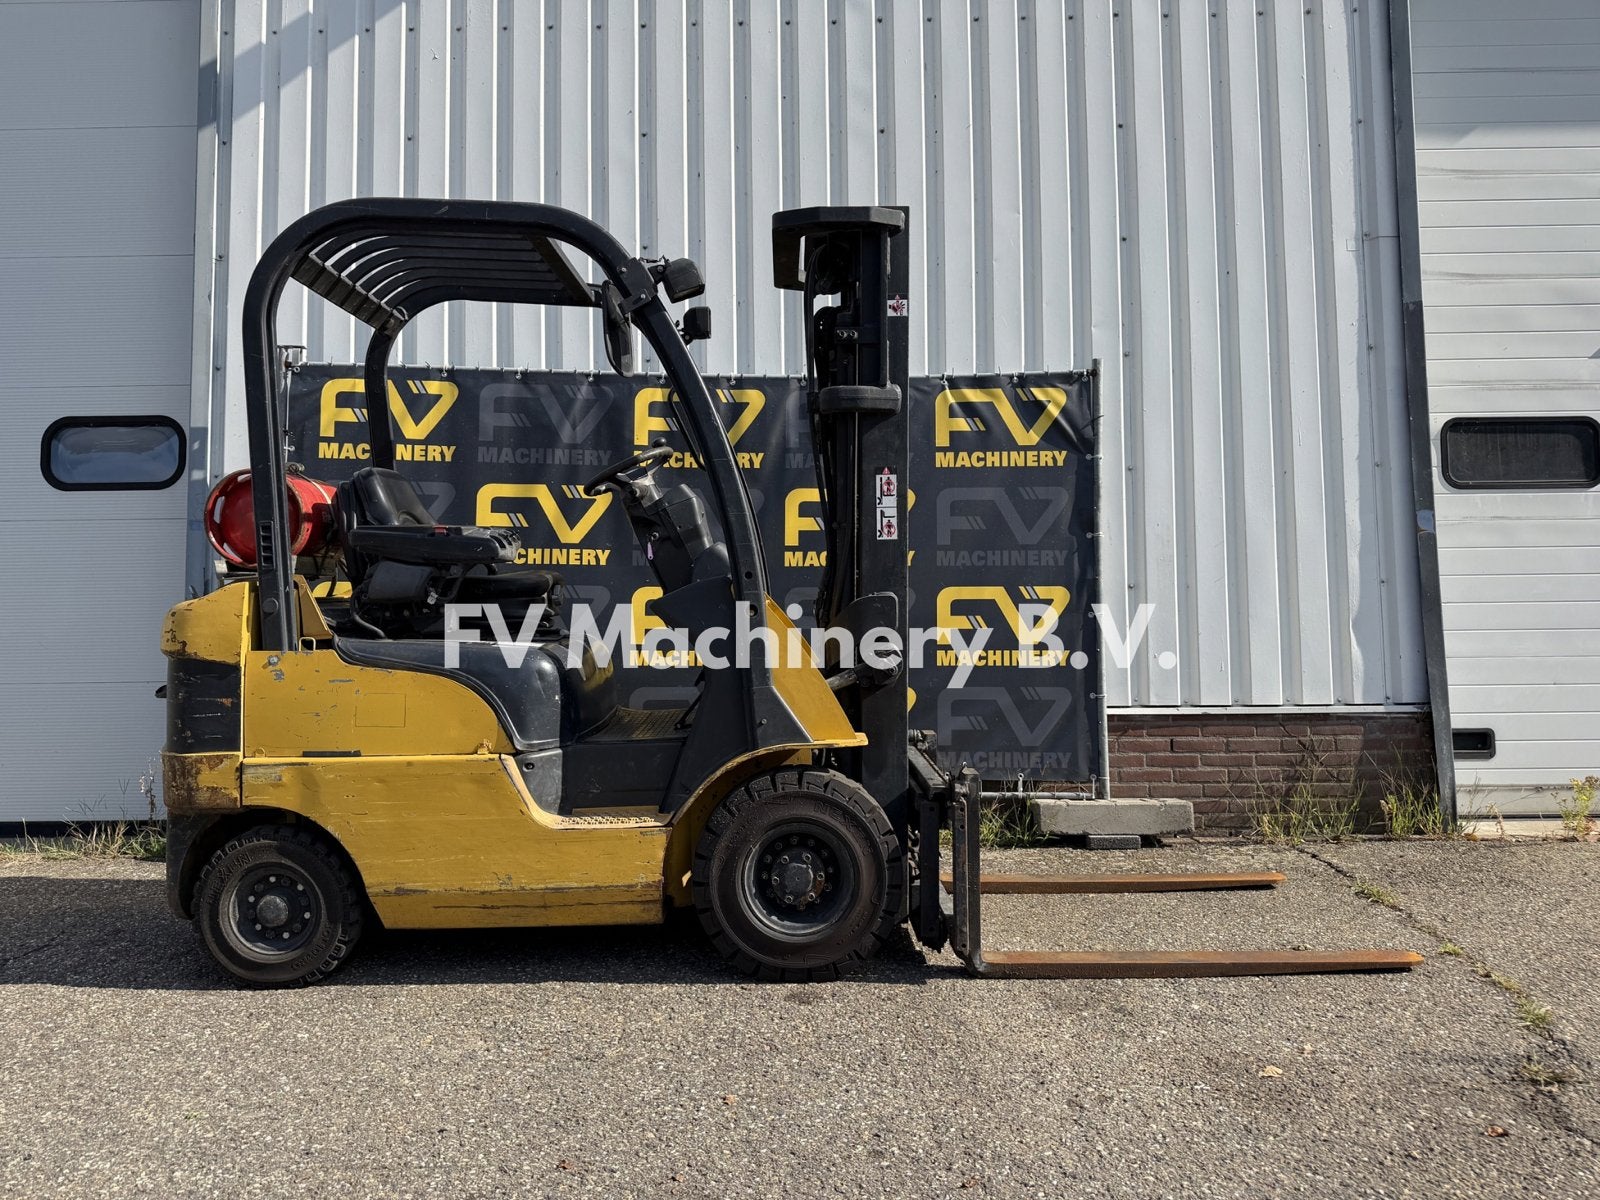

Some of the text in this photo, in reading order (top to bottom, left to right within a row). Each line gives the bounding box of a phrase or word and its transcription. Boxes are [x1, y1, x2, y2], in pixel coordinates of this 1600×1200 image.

[935, 387, 1067, 447] FV
[318, 442, 457, 462] MACNERY
[477, 446, 613, 466] MACHINERY
[935, 450, 1067, 468] MACHINERY
[506, 548, 611, 566] CHINERY
[936, 550, 1068, 567] MACHINERY
[936, 650, 1070, 667] MACHINERY
[937, 751, 1073, 770] MACHINERY
